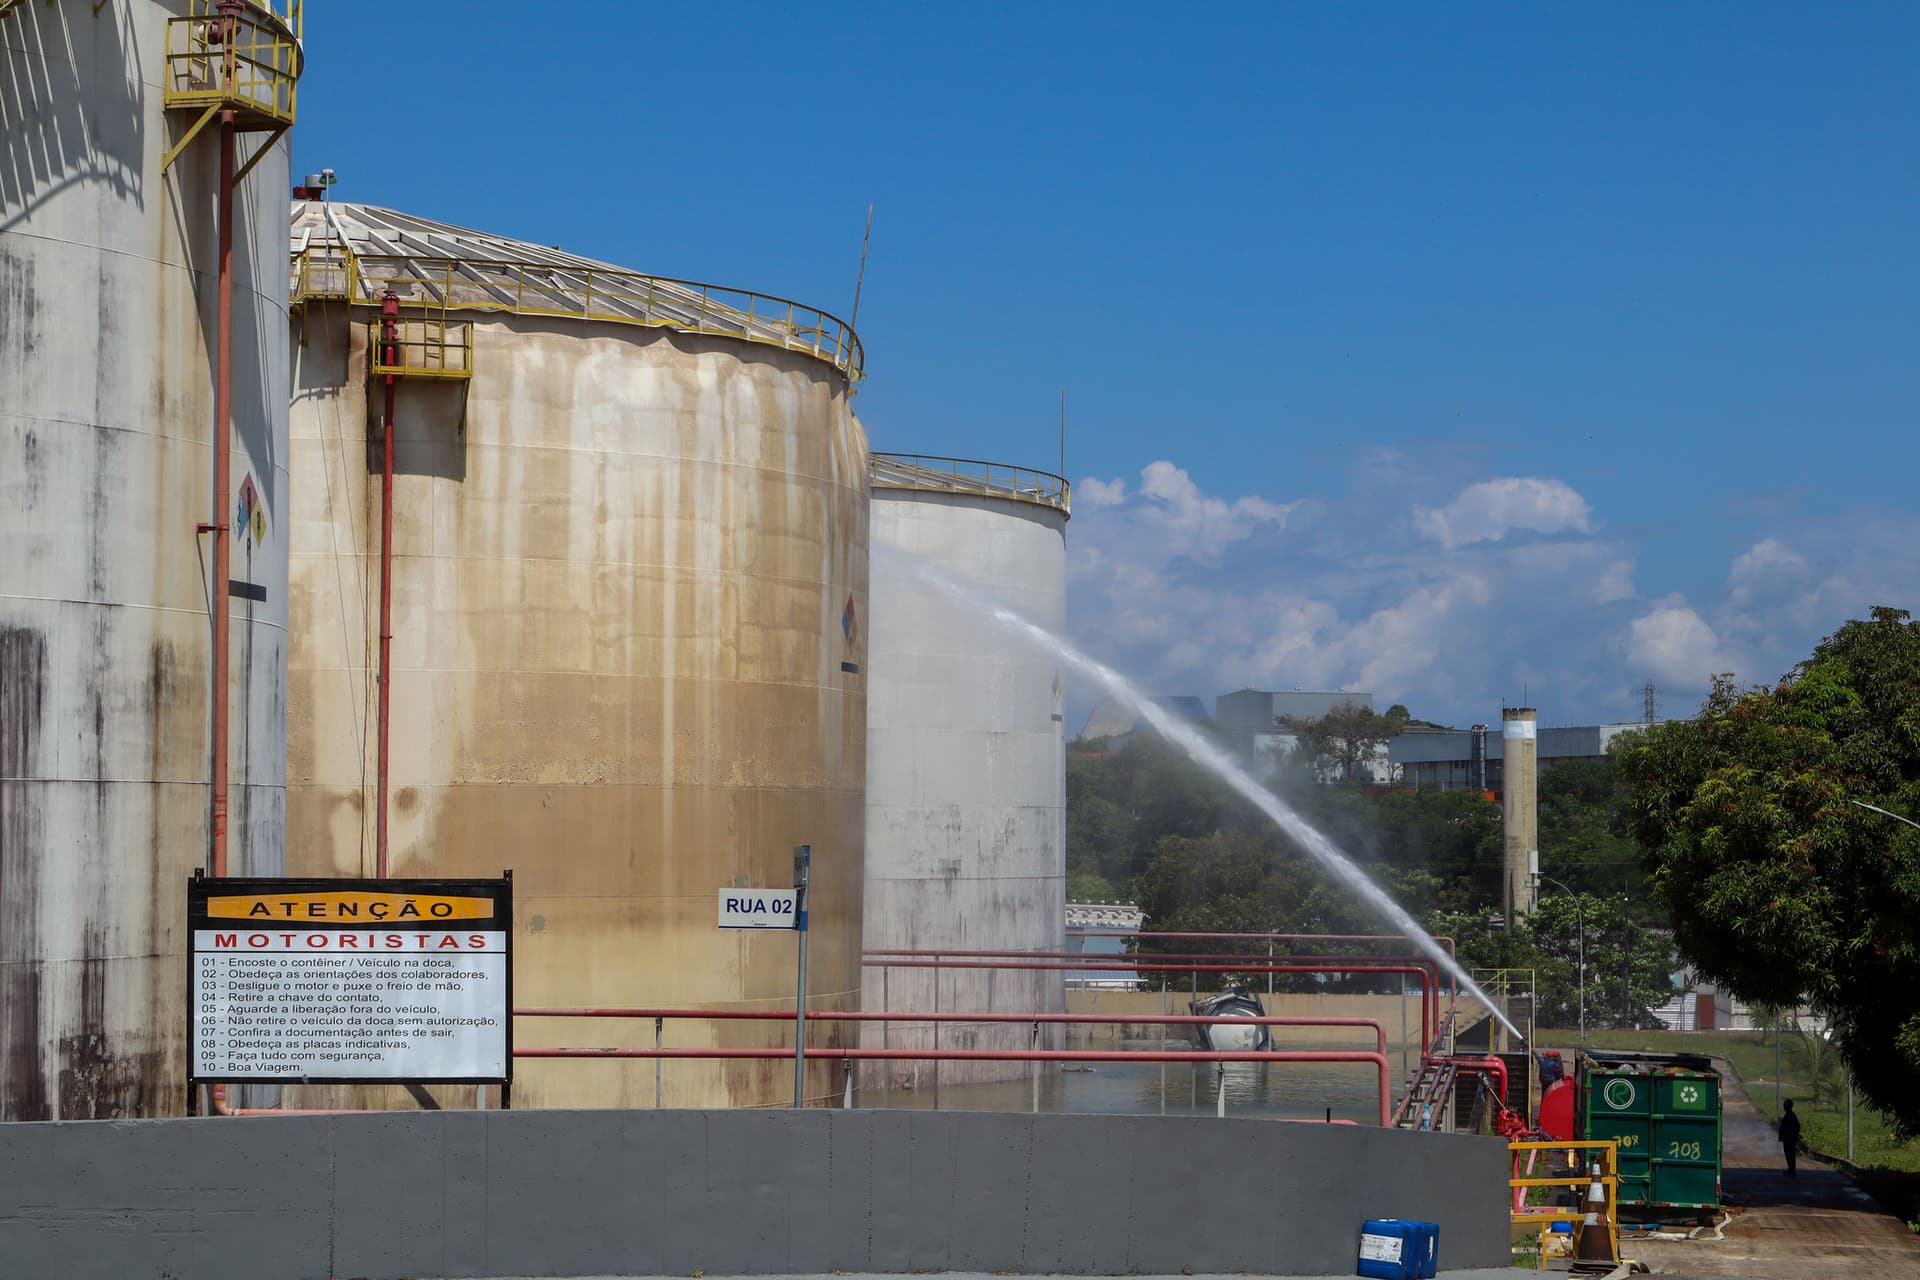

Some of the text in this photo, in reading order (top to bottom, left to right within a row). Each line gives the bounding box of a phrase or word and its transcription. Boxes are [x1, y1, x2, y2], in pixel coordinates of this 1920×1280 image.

[249, 899, 454, 921] ATENÇÃO
[726, 898, 792, 913] RUA 02
[215, 934, 487, 949] MOTORISTAS
[202, 958, 215, 967] 01
[229, 958, 276, 967] Encoste
[291, 958, 346, 967] contêiner
[349, 958, 354, 967] /
[357, 958, 400, 967] Veículo
[423, 959, 454, 968] doca,
[202, 969, 216, 979] 02
[229, 969, 282, 981] Obedeça
[304, 970, 372, 980] orientações
[376, 970, 397, 979] dos
[401, 970, 488, 981] colaboradores,
[202, 981, 216, 990] 03
[229, 980, 279, 992] Desligue
[295, 982, 329, 990] motor
[344, 984, 372, 992] puxe
[387, 981, 413, 990] freio
[417, 981, 431, 990] de
[435, 982, 463, 991] mão,
[202, 993, 216, 1002] 04
[229, 993, 263, 1001] Retire
[279, 993, 313, 1001] chave
[318, 993, 332, 1002] do
[336, 994, 382, 1003] contato,
[202, 1004, 216, 1014] 05
[227, 1004, 277, 1016] Aguarde
[293, 1005, 346, 1016] liberação
[350, 1005, 372, 1014] fora
[377, 1005, 391, 1013] do
[395, 1005, 440, 1015] veículo,
[202, 1016, 216, 1025] 06
[229, 1016, 252, 1025] Não
[257, 1016, 286, 1025] retire
[301, 1015, 343, 1025] veículo
[347, 1016, 361, 1025] da
[366, 1017, 393, 1025] doca
[427, 1016, 497, 1027] autorização,
[202, 1028, 215, 1036] 07
[228, 1028, 270, 1037] Confira
[286, 1028, 372, 1039] documentação
[376, 1028, 408, 1036] antes
[413, 1028, 427, 1037] de
[431, 1028, 454, 1038] sair,
[201, 1040, 215, 1049] 08
[228, 1039, 281, 1051] Obedeça
[304, 1040, 341, 1050] placas
[346, 1040, 410, 1049] indicativas,
[201, 1051, 215, 1060] 09
[228, 1051, 257, 1062] Faça
[262, 1051, 287, 1060] tudo
[320, 1053, 384, 1062] segurança,
[203, 1063, 216, 1071] 10
[228, 1063, 251, 1071] Boa
[256, 1063, 303, 1073] Viagem.
